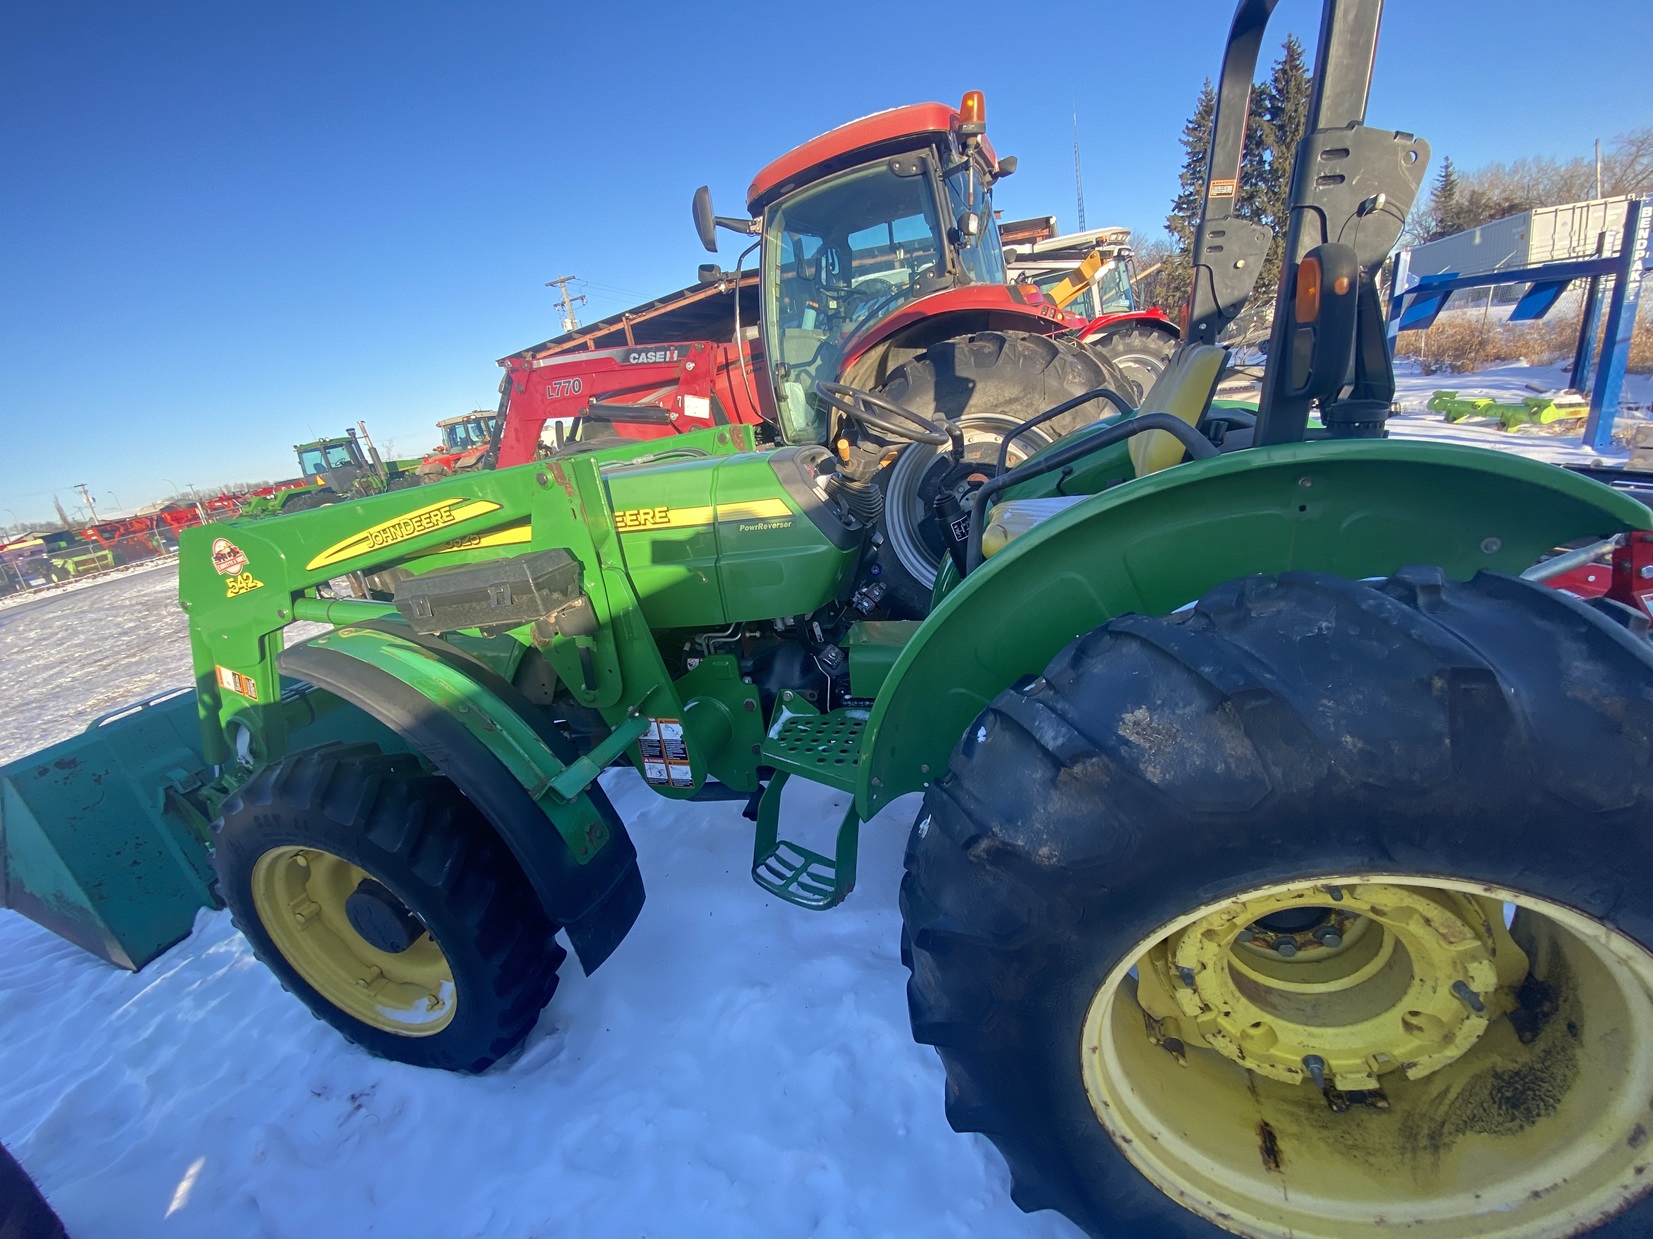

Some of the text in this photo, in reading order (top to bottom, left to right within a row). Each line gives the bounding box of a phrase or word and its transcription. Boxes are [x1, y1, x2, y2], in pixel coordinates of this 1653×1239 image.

[1630, 206, 1652, 280] BENDPAK
[629, 351, 665, 364] CASE
[546, 377, 583, 398] L770
[366, 505, 456, 549] JOHN DEERE
[739, 521, 793, 532] PowrReverser
[225, 572, 258, 595] 542
